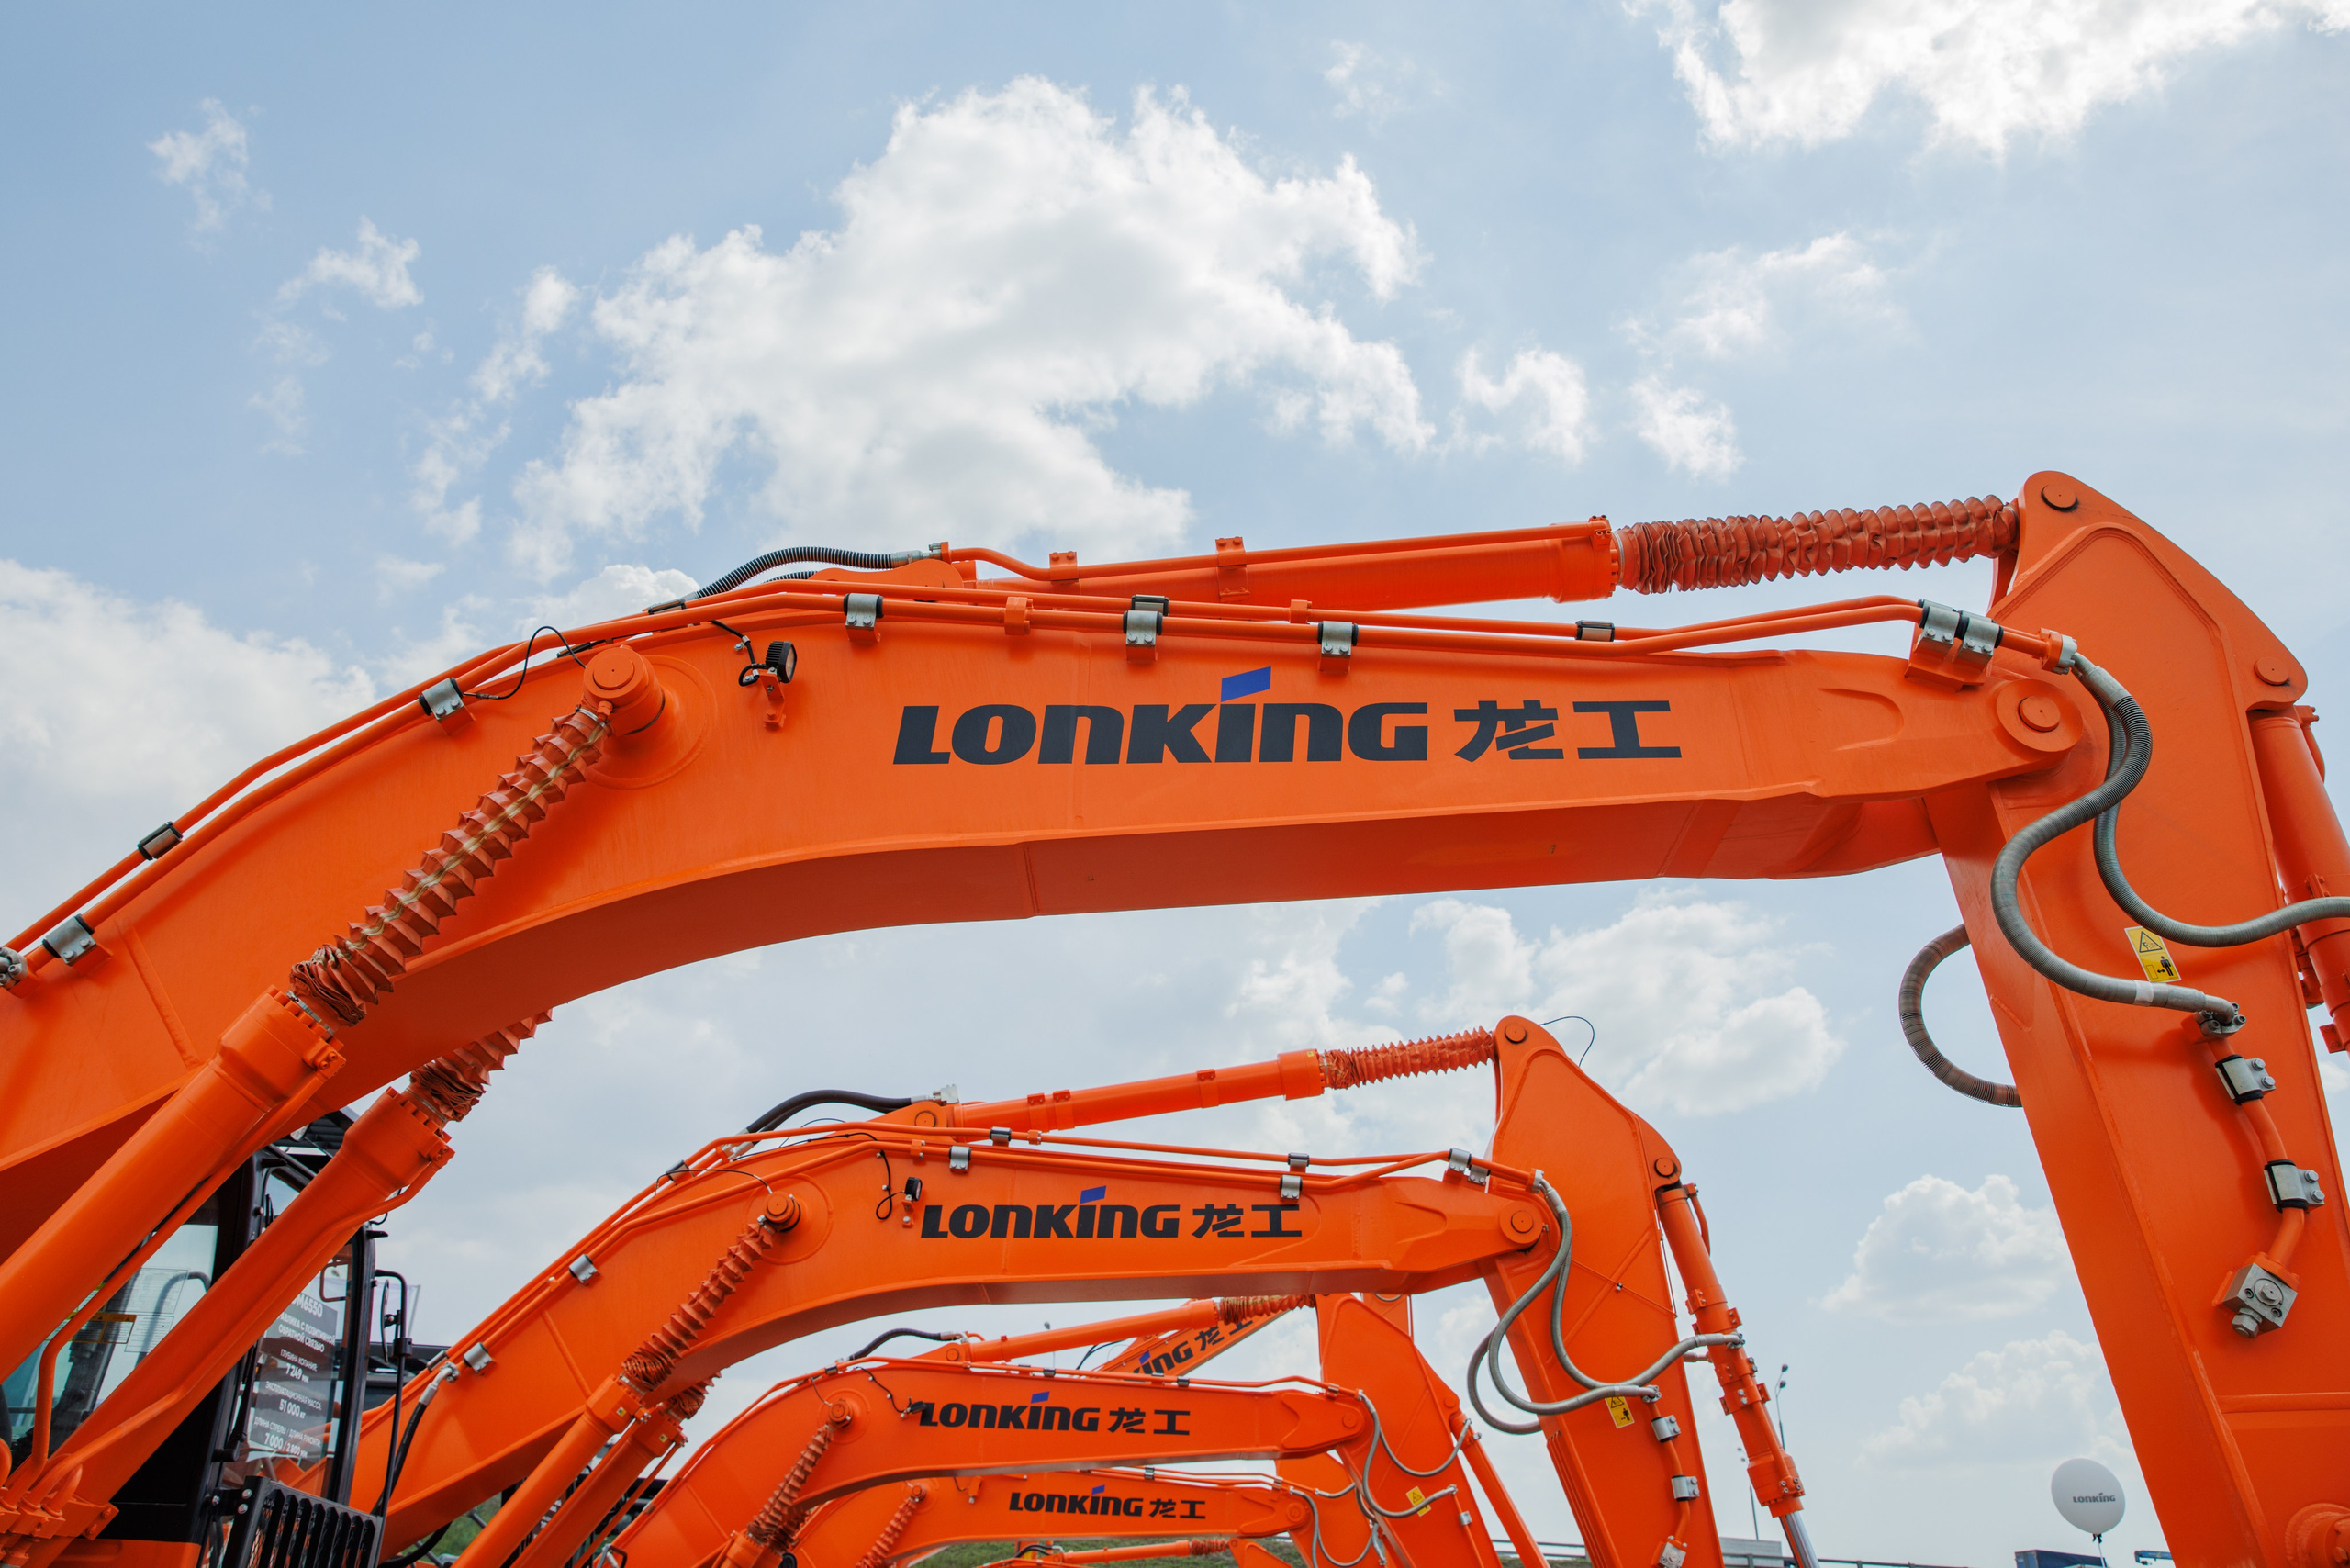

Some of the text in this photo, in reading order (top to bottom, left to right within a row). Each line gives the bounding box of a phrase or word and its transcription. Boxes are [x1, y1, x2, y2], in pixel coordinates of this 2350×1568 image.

[1453, 699, 1682, 763] 龙工
[1191, 1204, 1303, 1239] 龙工
[304, 1337, 325, 1353] СВЯЗЬЮ
[1107, 1406, 1191, 1436] 龙工
[1148, 1497, 1207, 1519] 龙工
